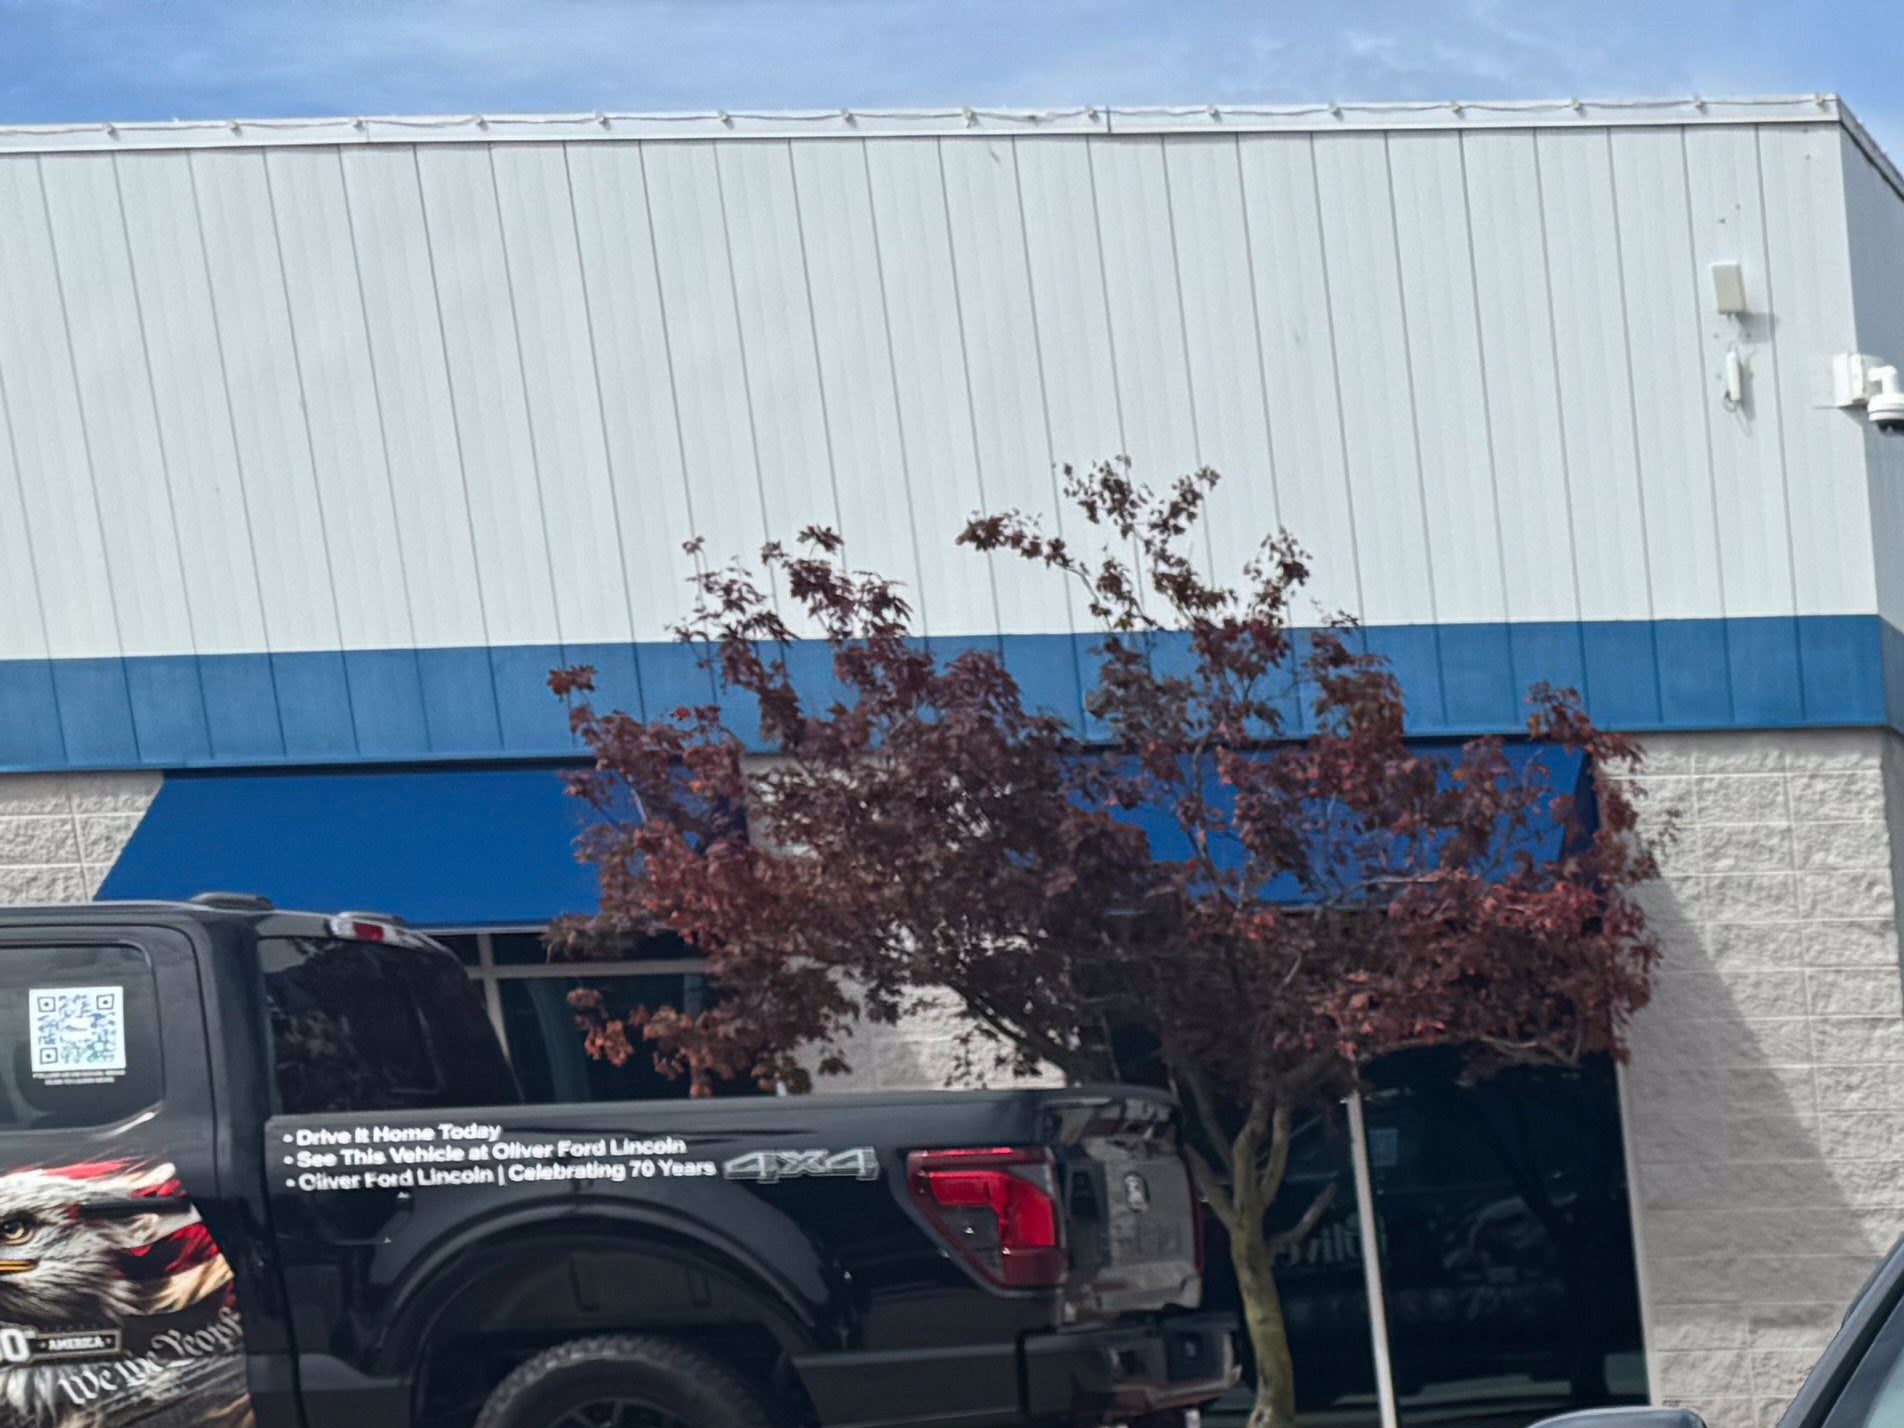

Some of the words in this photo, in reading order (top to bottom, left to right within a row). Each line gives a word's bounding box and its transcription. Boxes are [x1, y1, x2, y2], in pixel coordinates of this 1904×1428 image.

[296, 1129, 351, 1146] Drive
[354, 1127, 370, 1143] It
[372, 1125, 436, 1142] Home
[438, 1122, 503, 1142] Today
[297, 1150, 338, 1168] See
[340, 1148, 387, 1166] This
[389, 1145, 465, 1164] Vehicle
[468, 1147, 489, 1161] at
[492, 1142, 554, 1160] Oliver
[557, 1138, 605, 1158] Ford
[610, 1136, 688, 1156] Lincoln
[299, 1172, 361, 1191] Oliver
[364, 1169, 414, 1188] Ford
[417, 1167, 494, 1187] Lincoln
[508, 1160, 626, 1182] Celebrating
[628, 1158, 656, 1177] 70
[658, 1157, 717, 1176] Years
[48, 1336, 104, 1350] AMERICA
[58, 1365, 117, 1405] We
